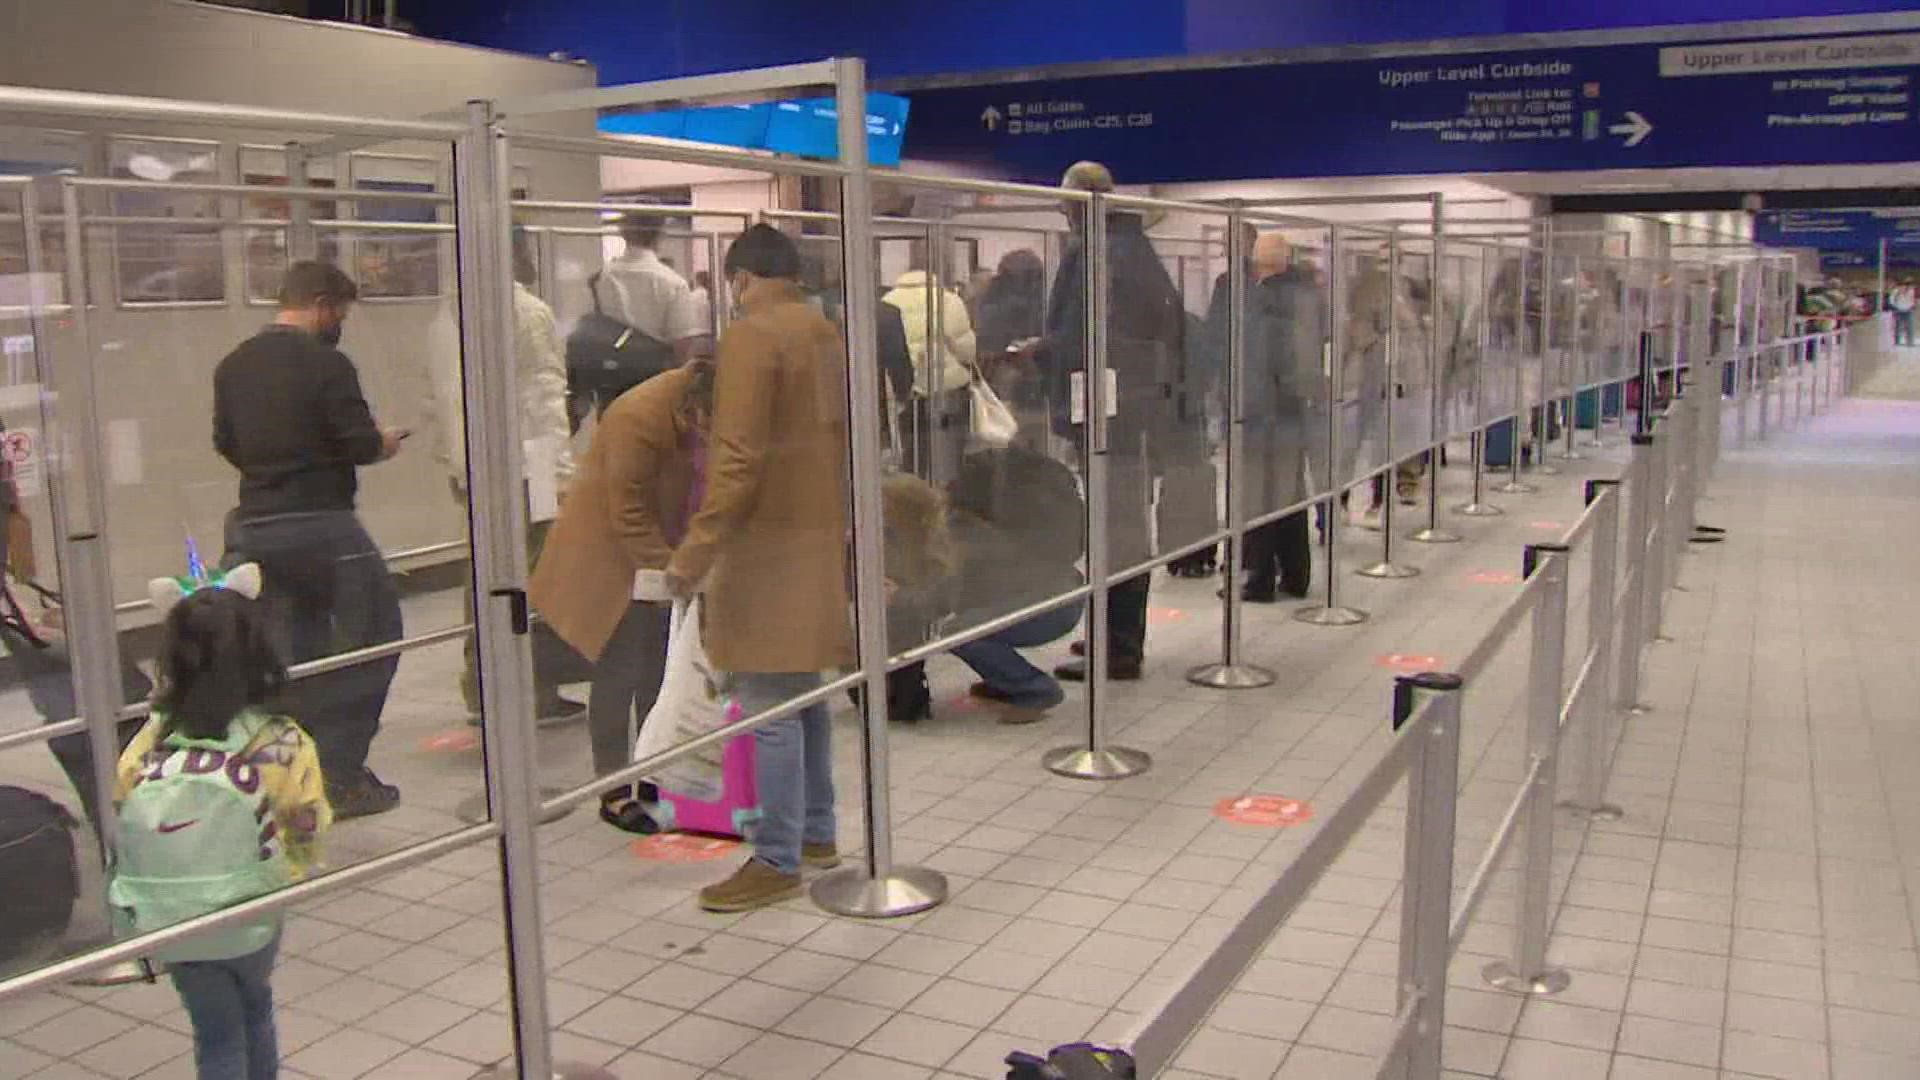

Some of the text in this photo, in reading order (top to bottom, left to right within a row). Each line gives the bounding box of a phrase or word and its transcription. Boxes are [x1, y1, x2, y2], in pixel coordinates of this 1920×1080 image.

[1683, 51, 1744, 69] Upper
[1753, 49, 1806, 64] Level
[1379, 60, 1572, 88] Upper Level Curbside
